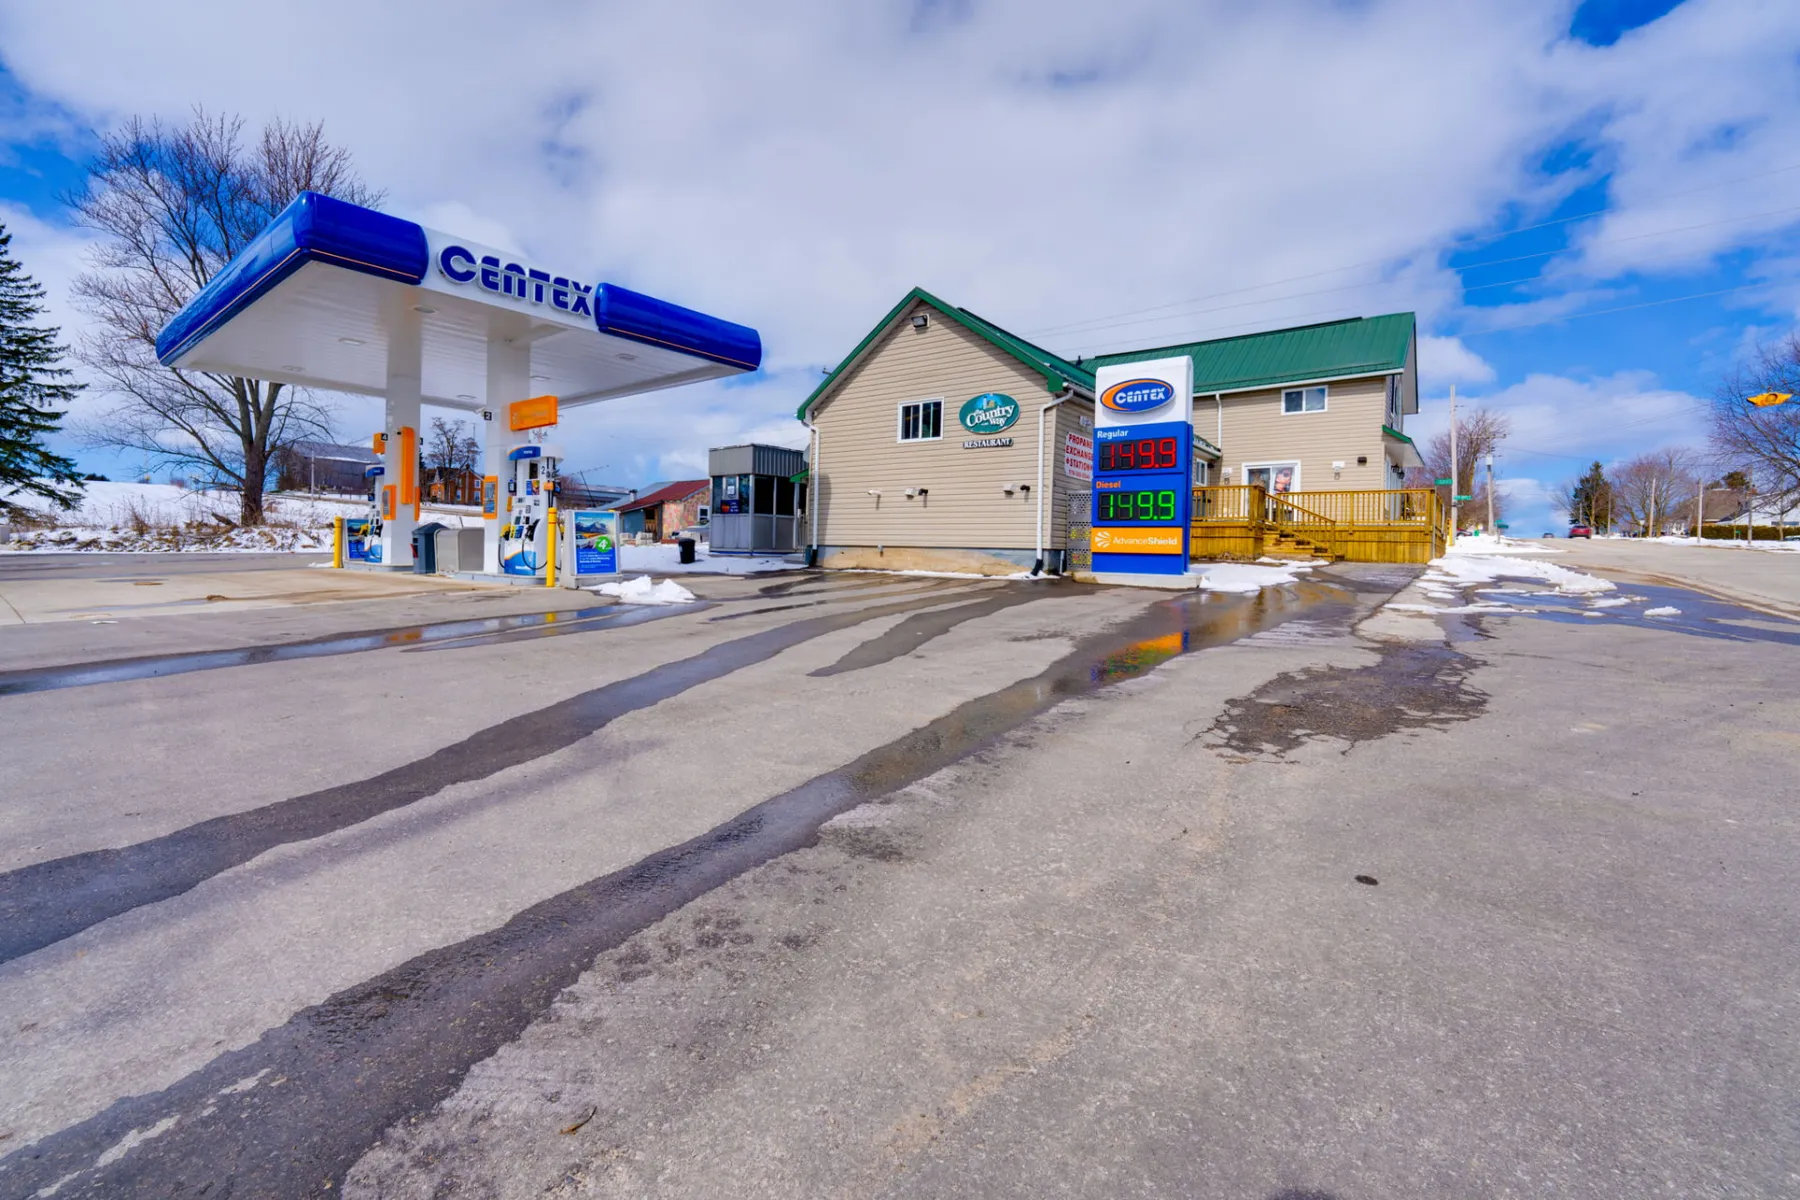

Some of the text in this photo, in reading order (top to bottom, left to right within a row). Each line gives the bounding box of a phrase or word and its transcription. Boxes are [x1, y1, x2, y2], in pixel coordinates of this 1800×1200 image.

[439, 245, 592, 317] CENTEX
[1115, 387, 1166, 404] CENTEX
[485, 412, 491, 420] 2
[966, 404, 1015, 427] Country
[1068, 433, 1093, 449] PROPANE
[1097, 429, 1129, 440] Regular
[964, 438, 1010, 448] RESTAURANT
[1110, 437, 1177, 468] 149.9
[541, 466, 545, 475] 2
[1096, 480, 1121, 489] Diesel
[1110, 491, 1175, 520] 149.9
[1112, 536, 1178, 545] AdvanceShield
